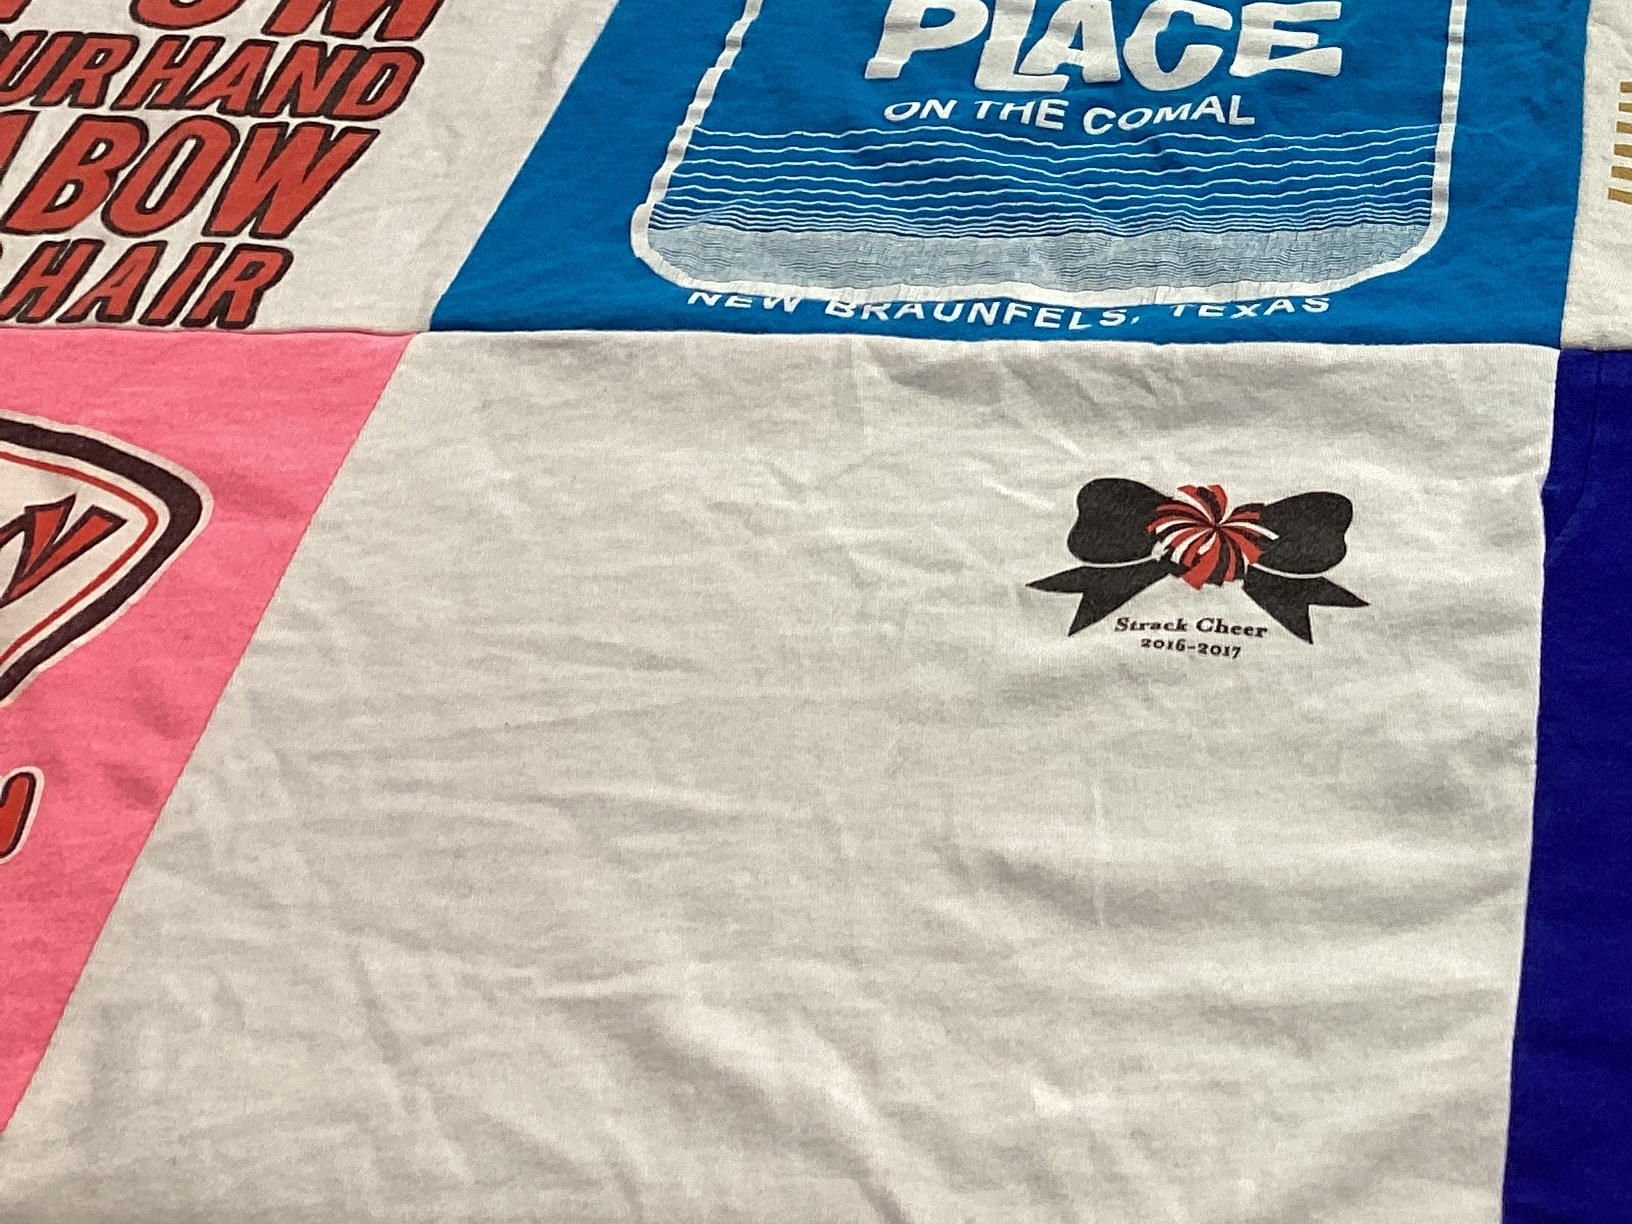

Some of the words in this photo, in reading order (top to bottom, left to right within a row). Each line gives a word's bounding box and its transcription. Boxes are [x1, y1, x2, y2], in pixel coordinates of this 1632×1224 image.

[110, 33, 425, 122] HAND
[882, 98, 957, 123] ON
[973, 98, 1071, 132] THE
[1083, 93, 1256, 137] COMAL
[0, 113, 381, 240] BOW
[0, 239, 295, 330] HAIR
[685, 290, 799, 316] NEW
[824, 296, 1142, 332] BRAUNFELS,
[1167, 295, 1331, 321] TEXAS
[1113, 616, 1189, 634] Strack
[1196, 616, 1269, 640] Cheer
[1140, 636, 1243, 661] 2016-2017
